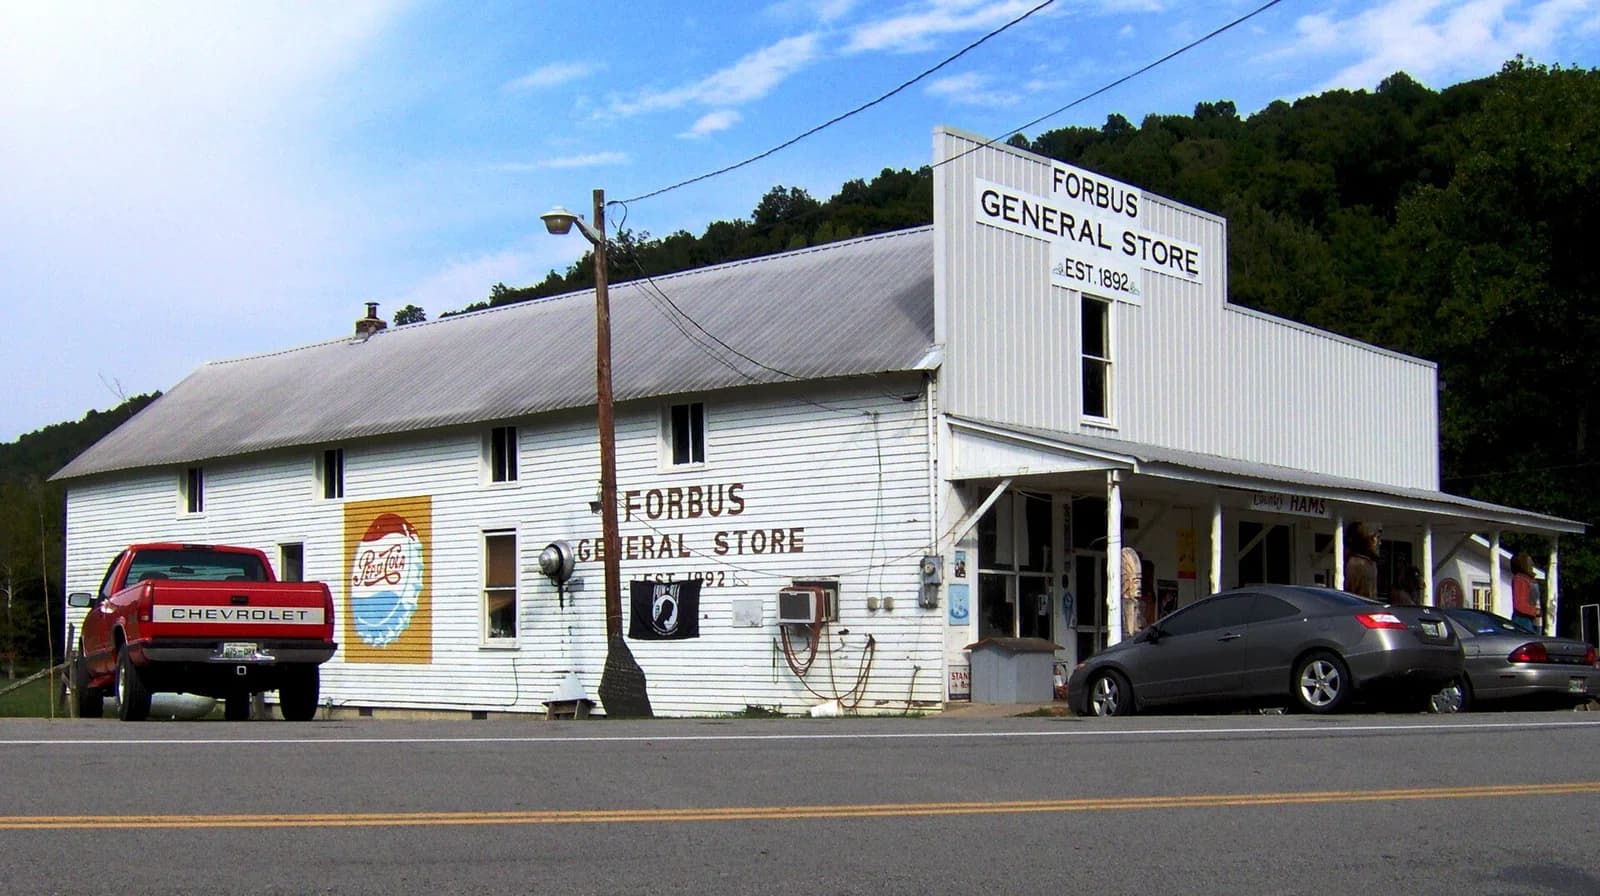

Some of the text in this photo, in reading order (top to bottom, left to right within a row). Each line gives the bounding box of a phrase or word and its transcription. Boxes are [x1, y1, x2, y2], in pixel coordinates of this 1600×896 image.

[1053, 167, 1138, 218] FORBUS
[981, 189, 1199, 275] GENERAL STORE
[1099, 268, 1129, 292] 1892
[624, 482, 745, 522] FORBUS
[1290, 495, 1326, 514] HAMS
[578, 527, 805, 562] GEERAL STORE
[171, 608, 309, 621] CHEVROLET
